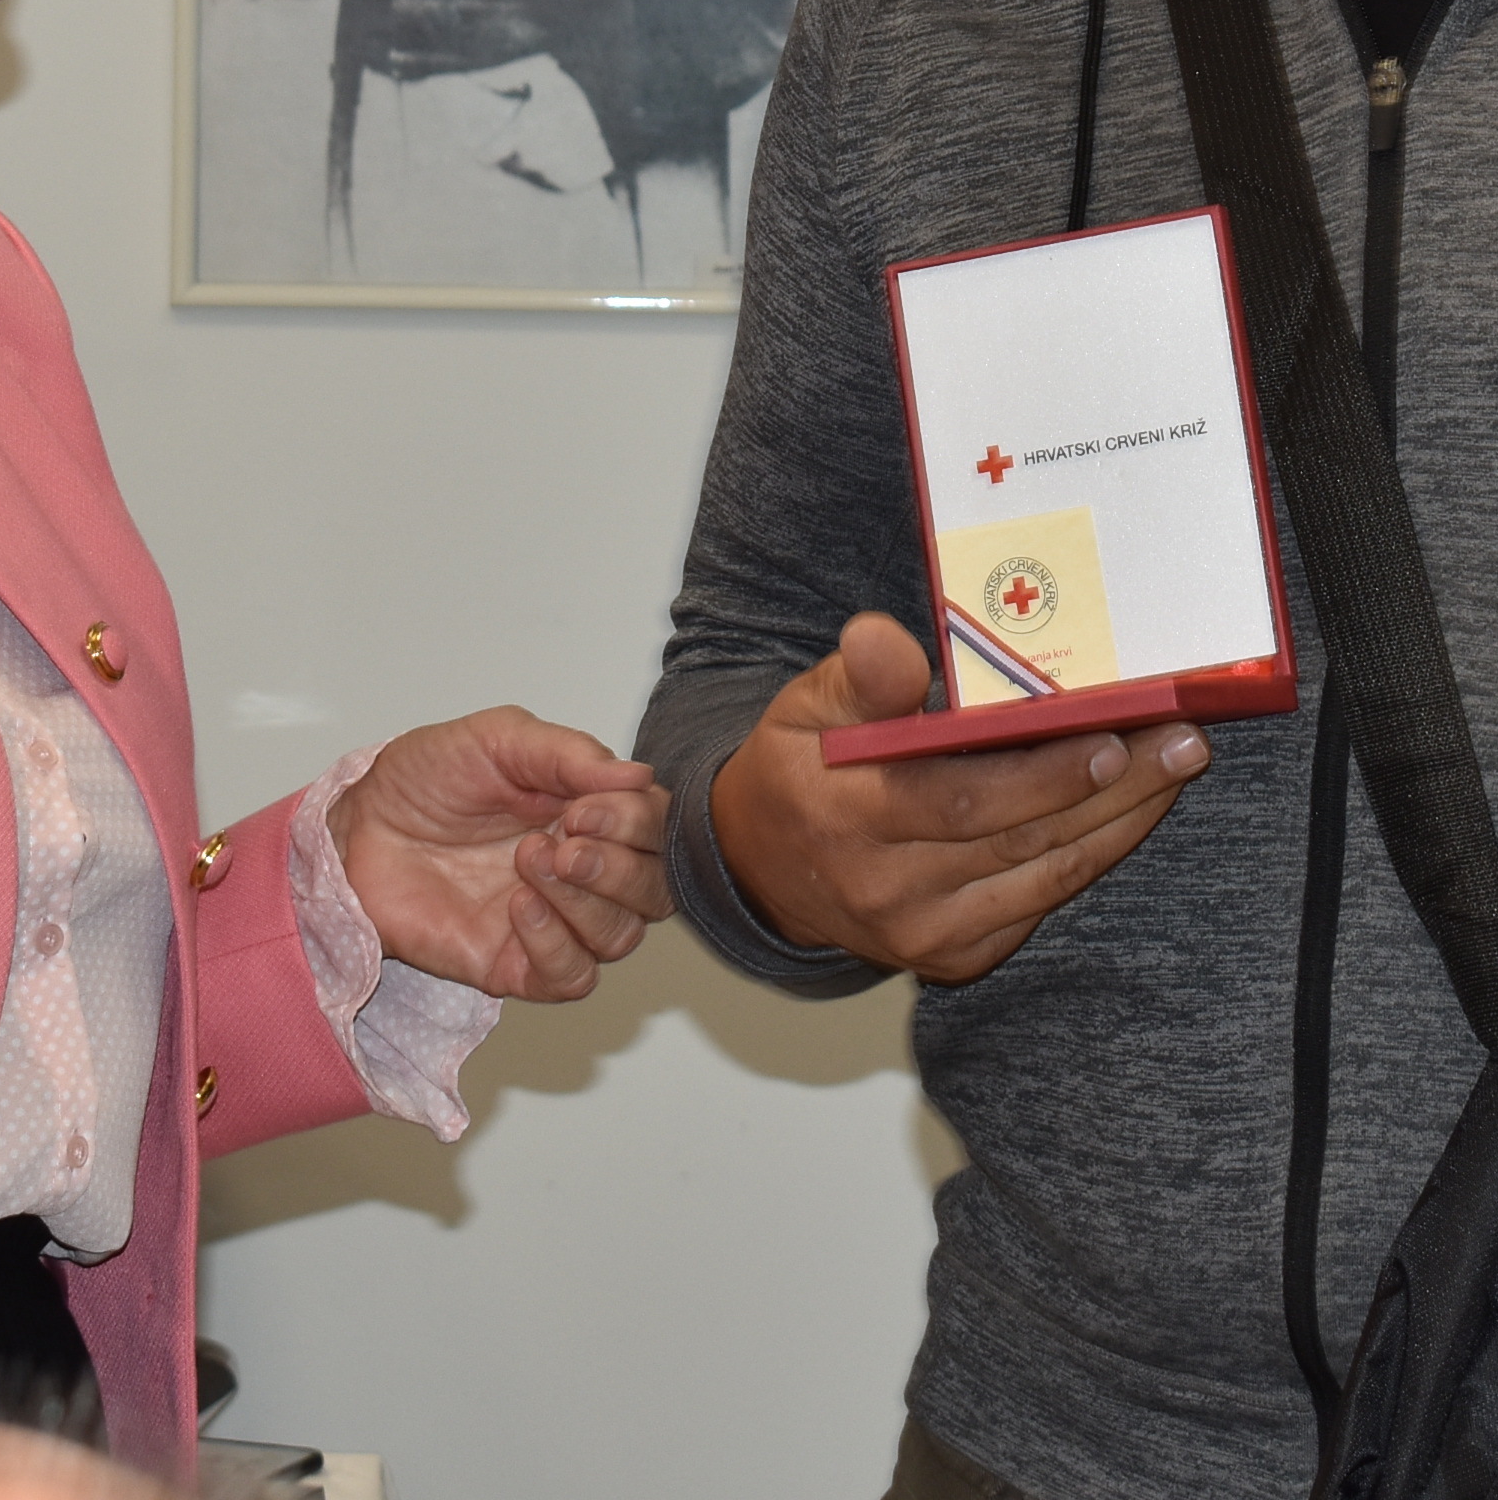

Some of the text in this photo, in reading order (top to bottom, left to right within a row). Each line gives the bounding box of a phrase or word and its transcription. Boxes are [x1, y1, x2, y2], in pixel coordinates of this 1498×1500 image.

[1024, 417, 1208, 466] HRVATSKI CRVENI KRIŽ
[986, 565, 1007, 621] HRVATSKI
[1008, 559, 1050, 582] CRVENI
[1053, 645, 1073, 660] krvi
